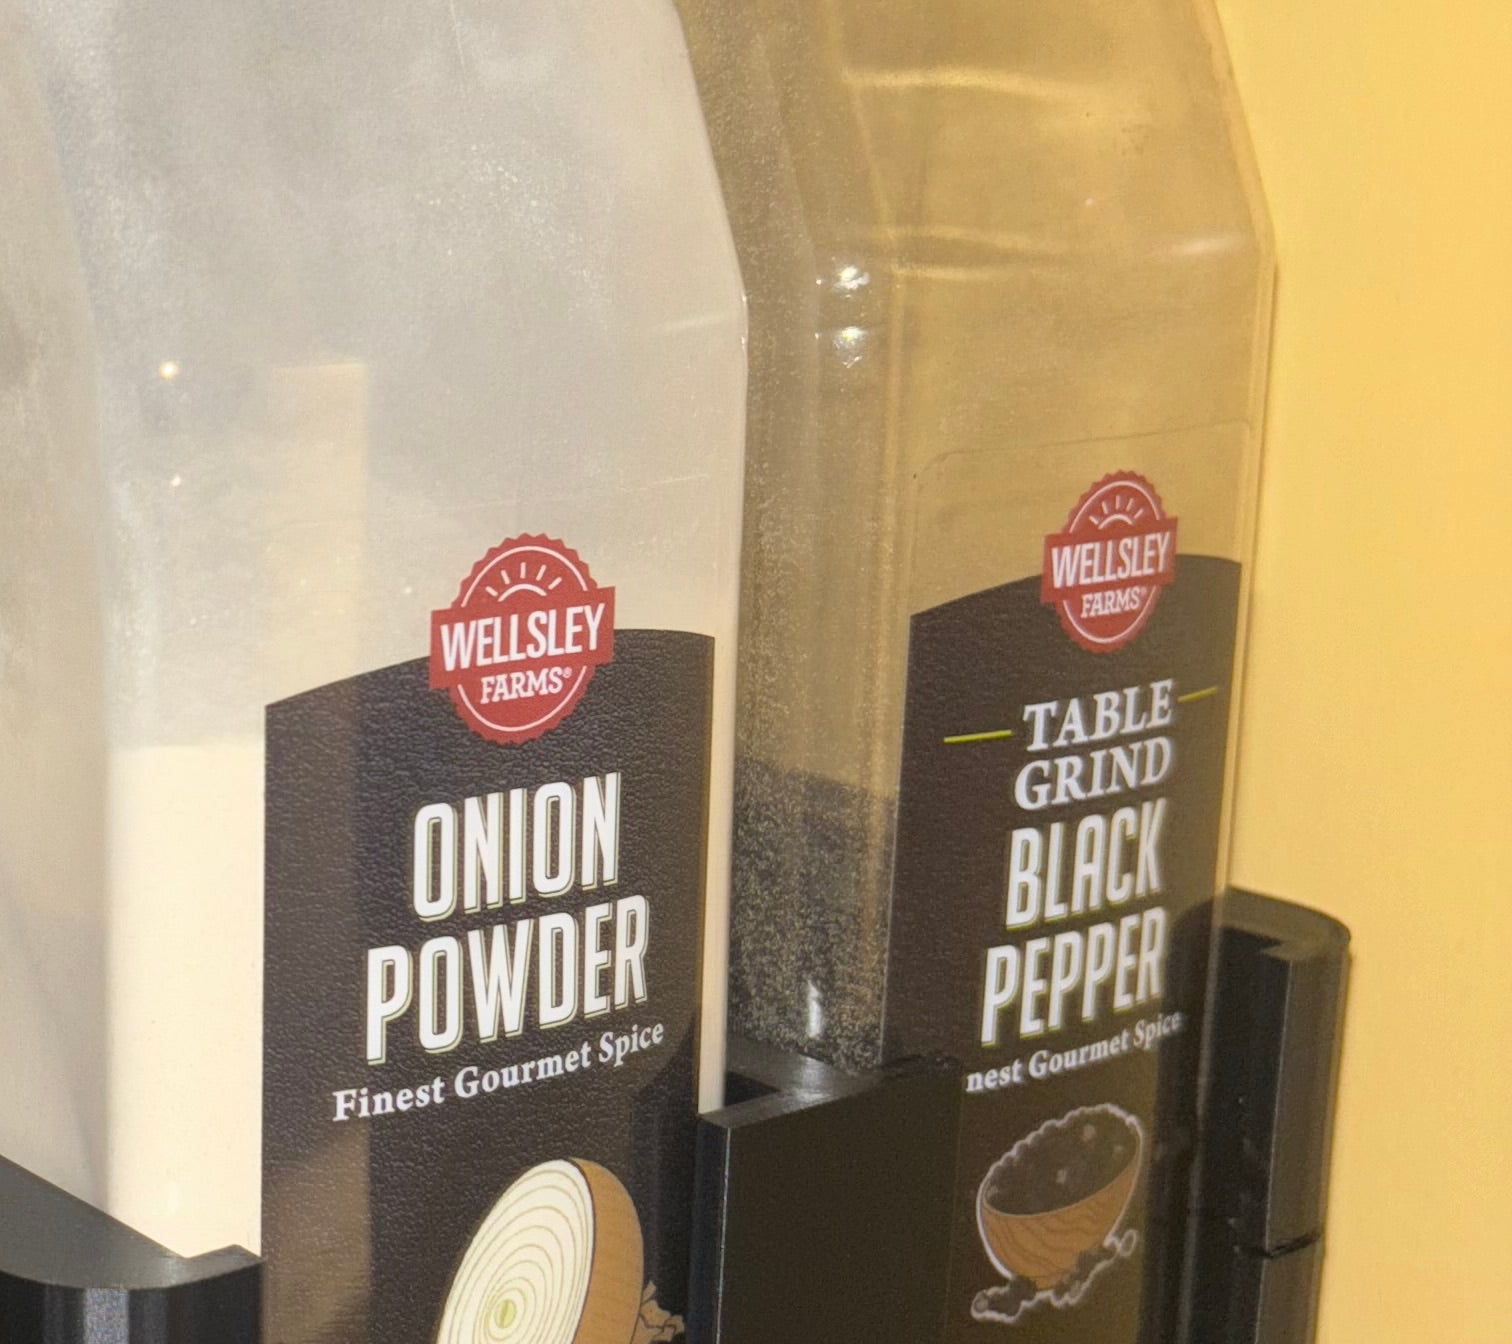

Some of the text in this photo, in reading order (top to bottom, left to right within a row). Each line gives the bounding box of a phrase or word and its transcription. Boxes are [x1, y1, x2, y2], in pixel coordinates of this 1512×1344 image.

[1051, 531, 1170, 589] WELLSLEY
[440, 603, 605, 672] WELLSLEY
[1023, 678, 1173, 752] TABLE
[1014, 738, 1172, 811] GRIND
[413, 770, 621, 922] ONION
[1005, 797, 1168, 930] BLACK
[366, 893, 650, 1066] POWDER
[981, 907, 1168, 1047] PEPPER
[332, 1020, 664, 1121] Finest Gourmet Spice
[965, 1011, 1182, 1093] nest Gourmet Spice
